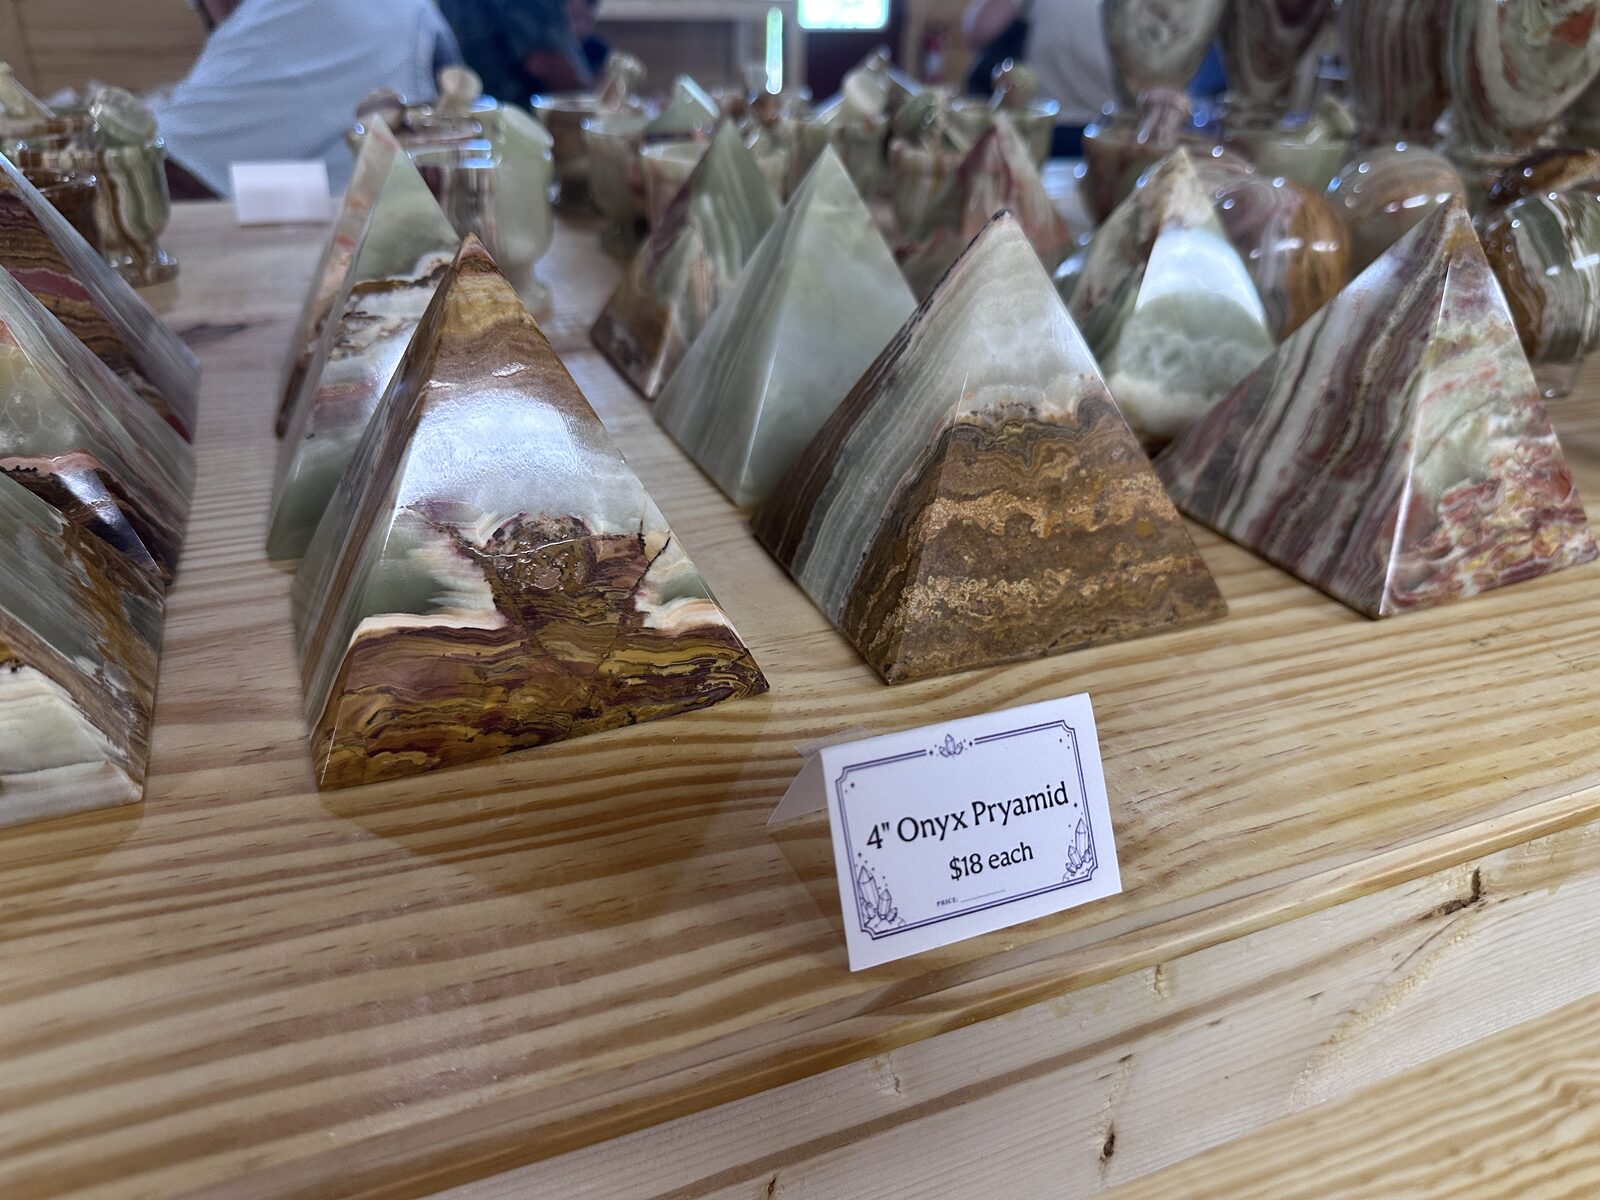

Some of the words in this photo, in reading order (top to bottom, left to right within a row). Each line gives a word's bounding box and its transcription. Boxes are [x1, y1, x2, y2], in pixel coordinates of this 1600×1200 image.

[866, 822, 890, 850] 4"
[897, 811, 968, 843] Onyx
[971, 781, 1069, 826] Pryamid
[949, 853, 983, 881] $18
[988, 842, 1034, 870] each
